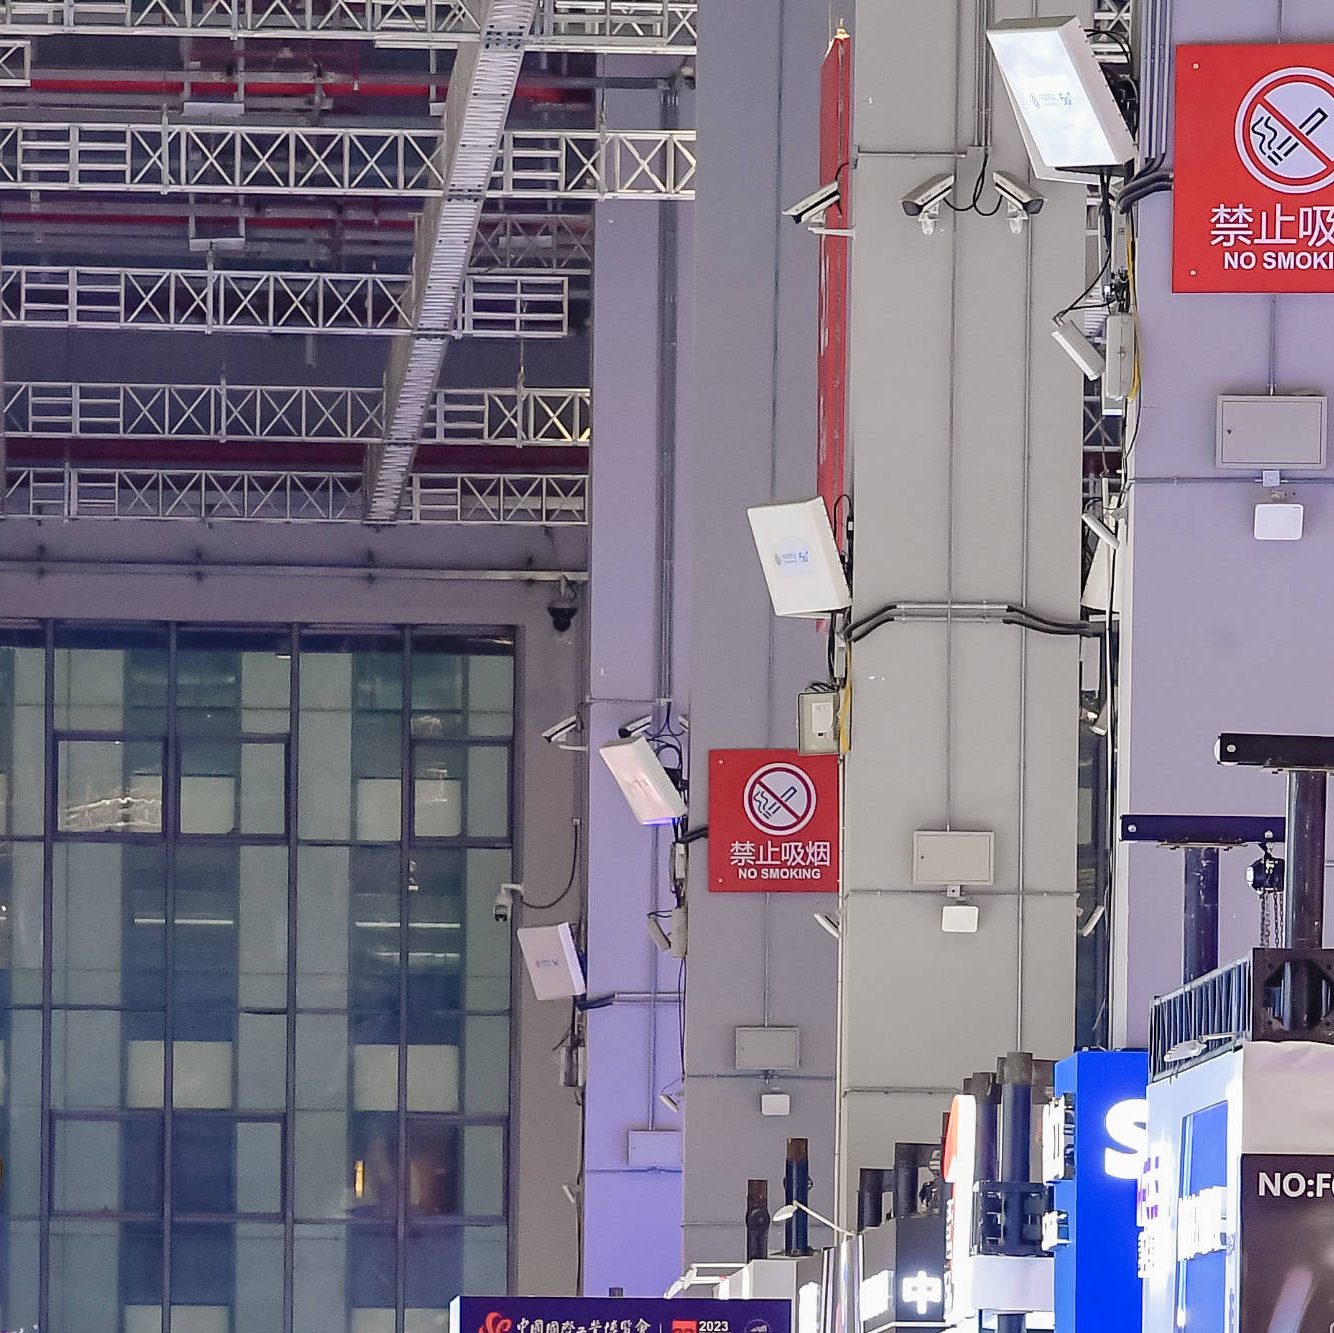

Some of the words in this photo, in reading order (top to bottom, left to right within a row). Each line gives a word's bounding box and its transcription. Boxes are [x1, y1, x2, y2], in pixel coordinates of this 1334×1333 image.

[1224, 251, 1257, 270] NO
[730, 840, 831, 867] 禁止吸烟
[738, 868, 758, 880] NO
[760, 868, 821, 880] SMOKING
[699, 1320, 729, 1332] 2023
